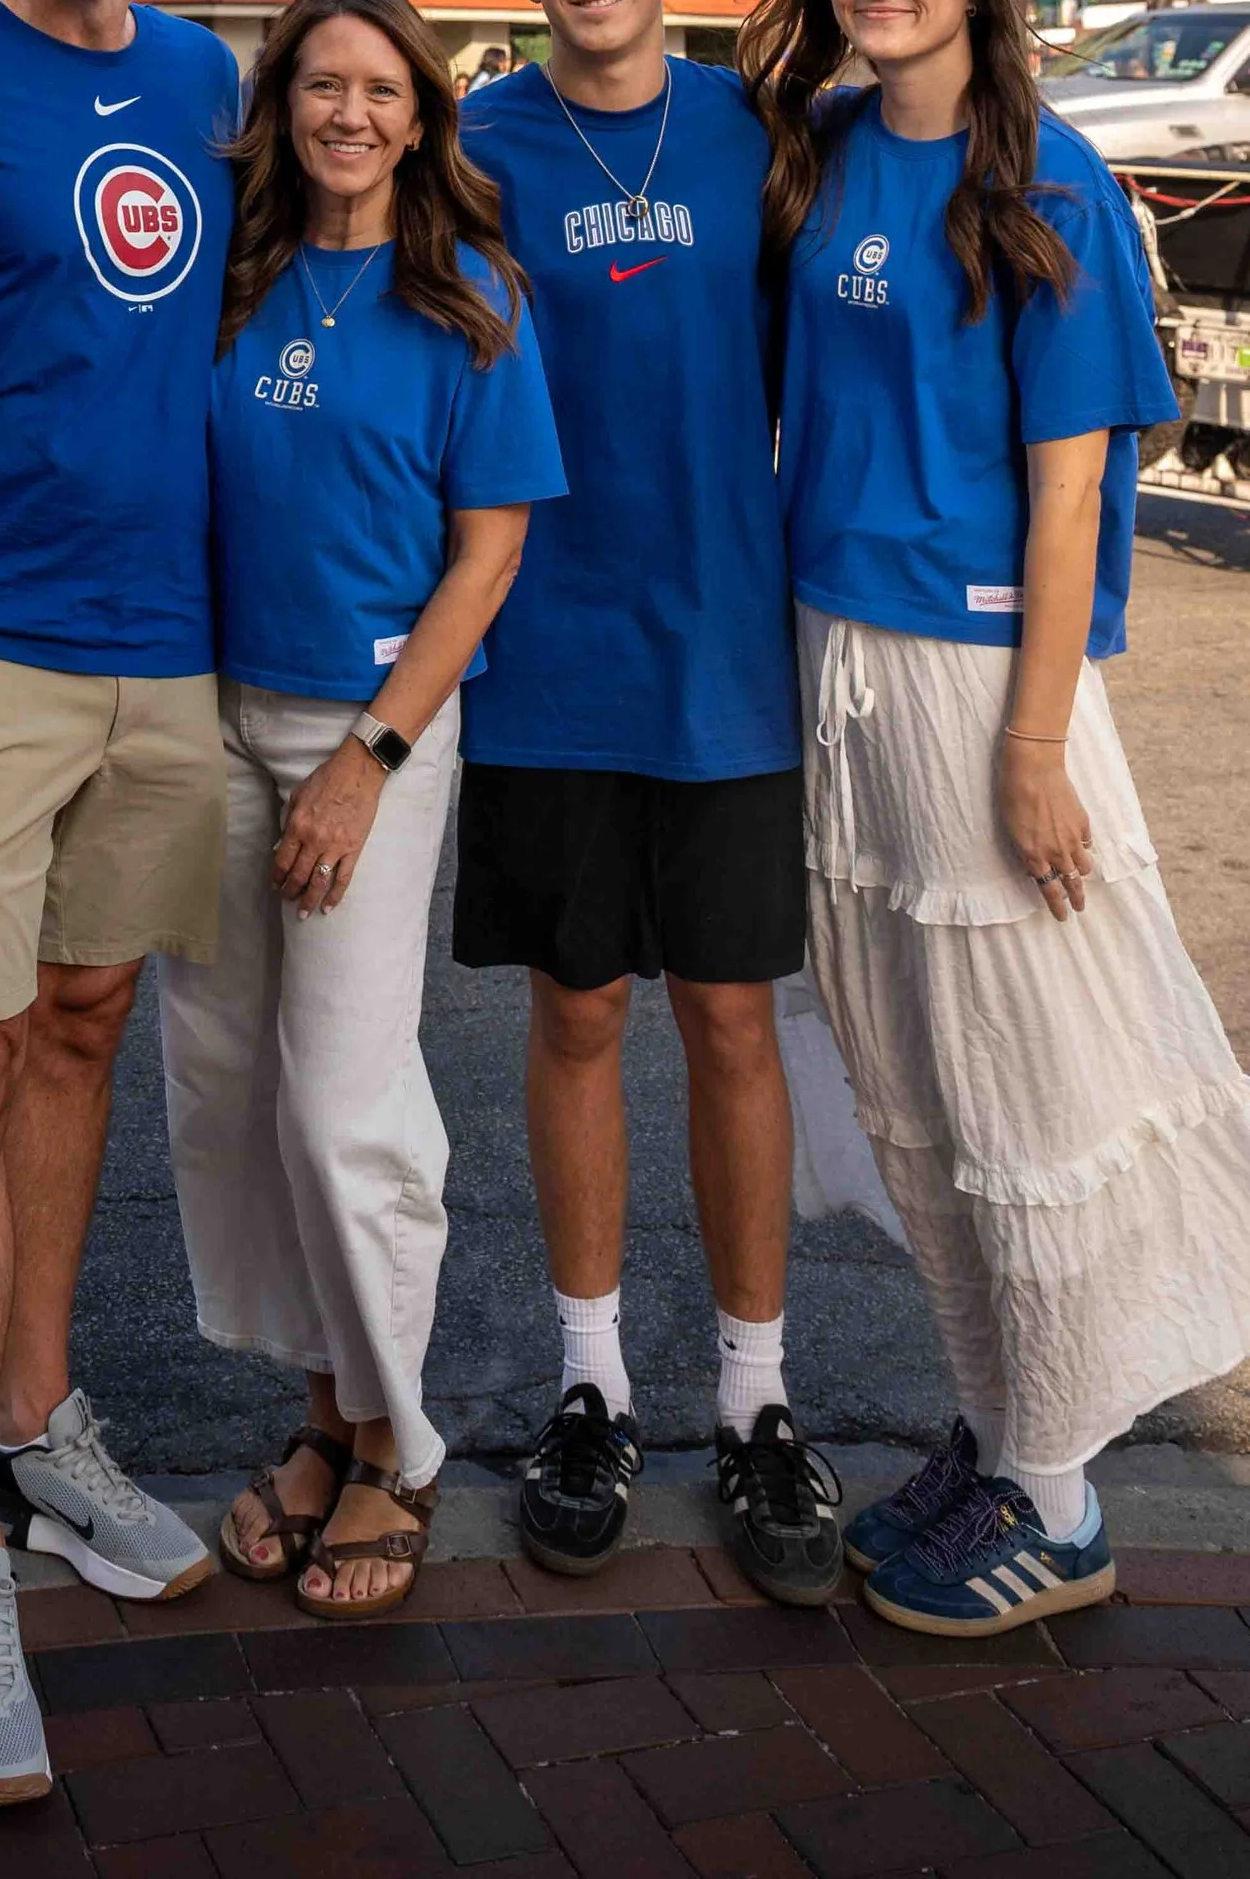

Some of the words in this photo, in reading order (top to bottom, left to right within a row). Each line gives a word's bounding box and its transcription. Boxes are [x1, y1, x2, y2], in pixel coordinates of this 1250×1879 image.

[564, 200, 694, 253] CHICAGO
[837, 273, 888, 304] CUBS
[254, 375, 319, 407] CUBS
